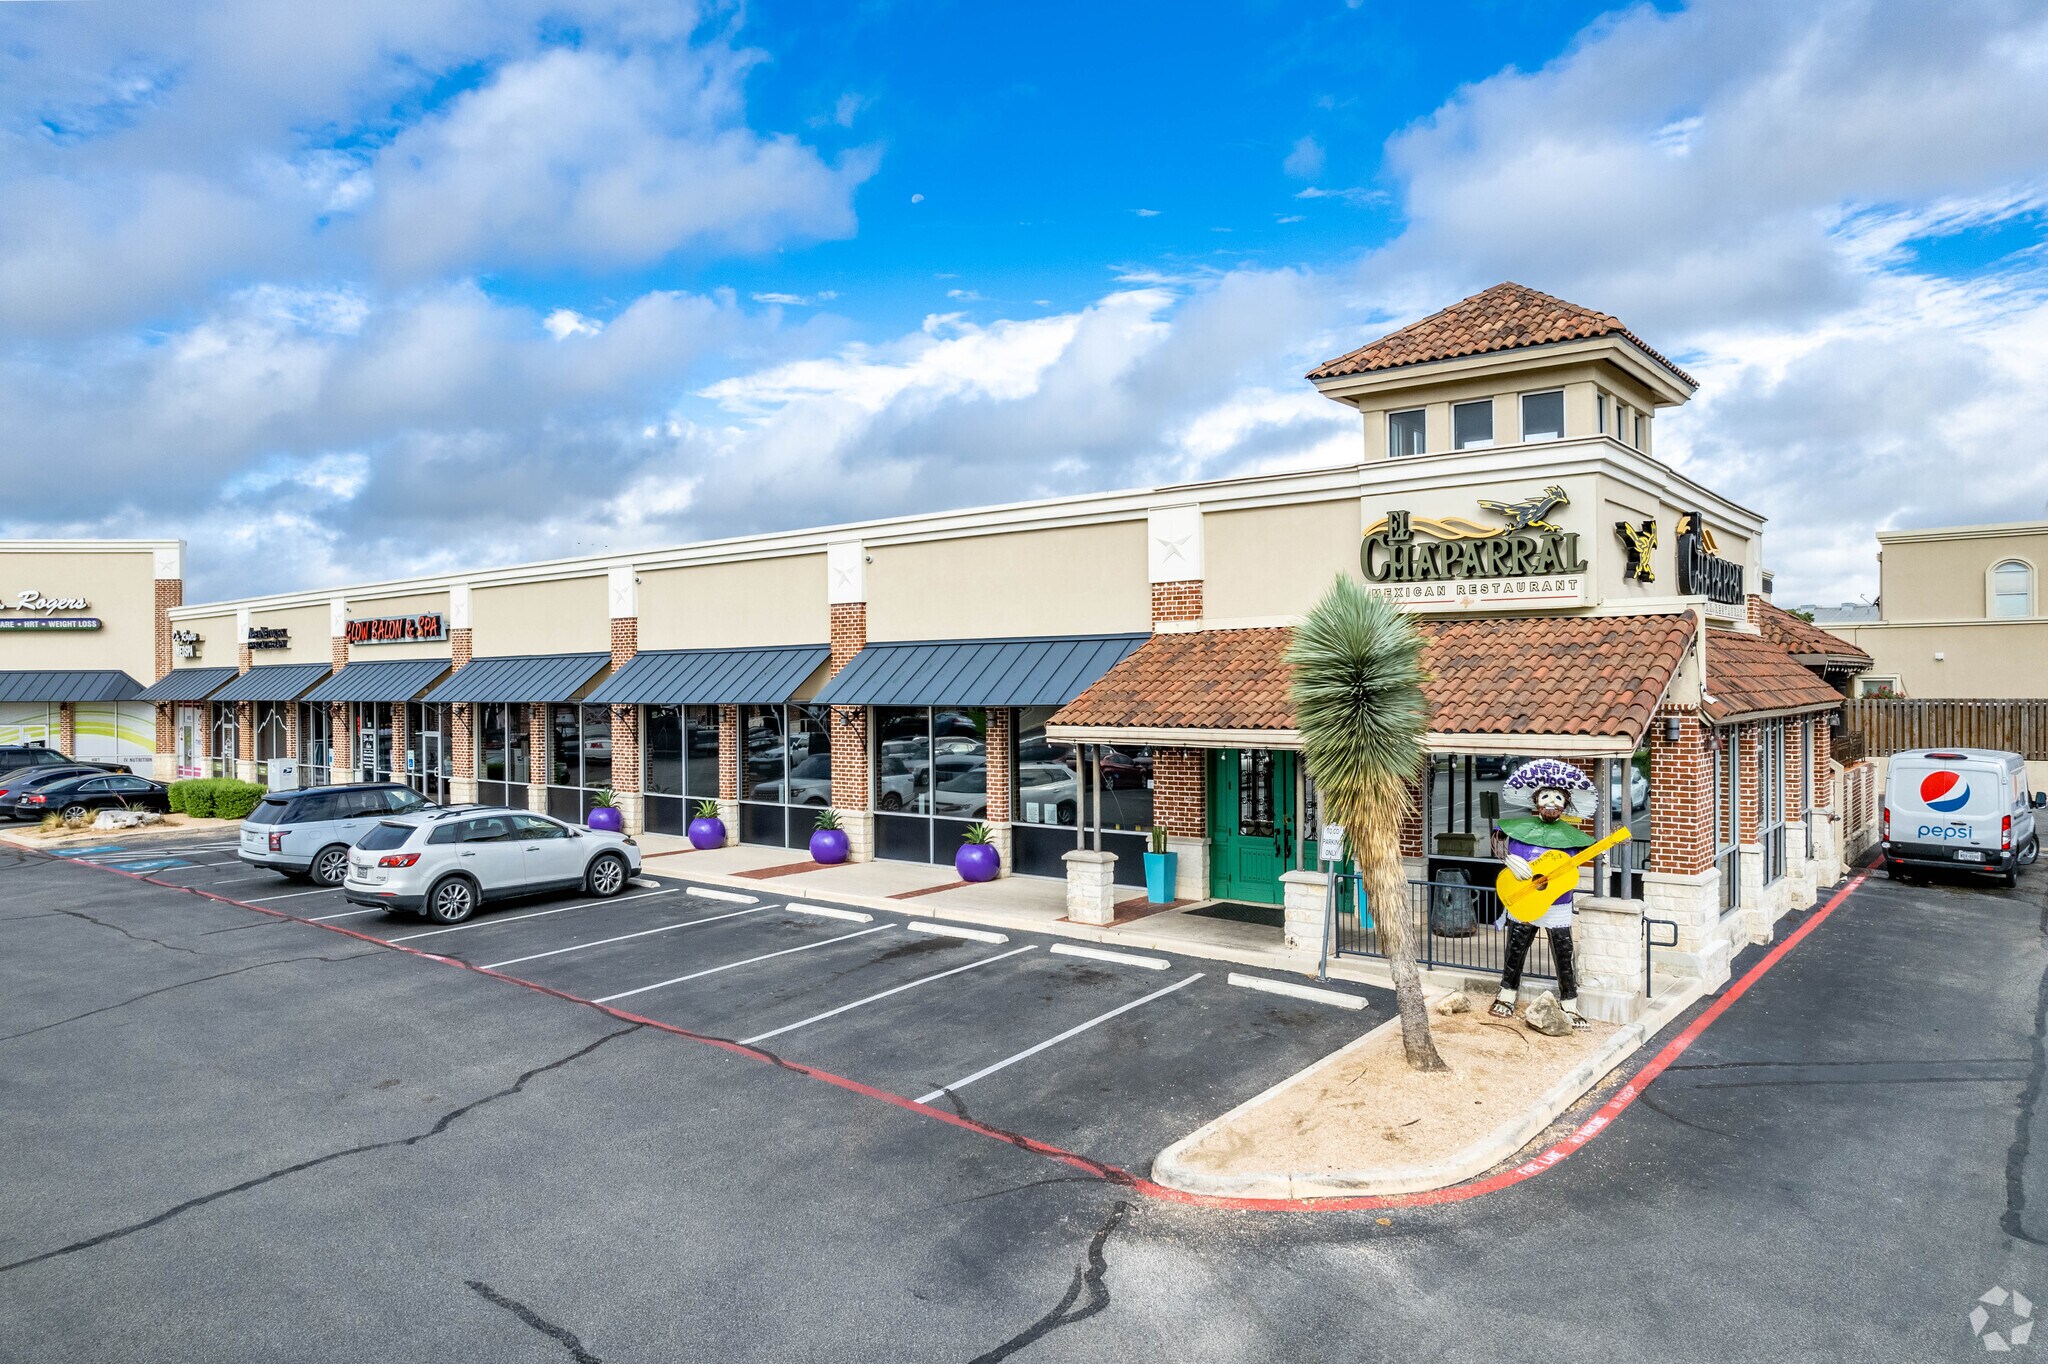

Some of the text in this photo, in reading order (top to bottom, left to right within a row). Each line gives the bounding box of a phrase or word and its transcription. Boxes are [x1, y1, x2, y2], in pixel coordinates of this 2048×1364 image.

[1386, 510, 1414, 541] EL
[1360, 532, 1588, 582] CHAPARRAL
[1371, 580, 1578, 598] MEXICAN RESTAURANT
[16, 590, 88, 616] Rogers
[345, 616, 439, 641] GLOW SALON & SPA
[1323, 838, 1341, 846] PARKIN
[1918, 825, 1972, 840] pepsi
